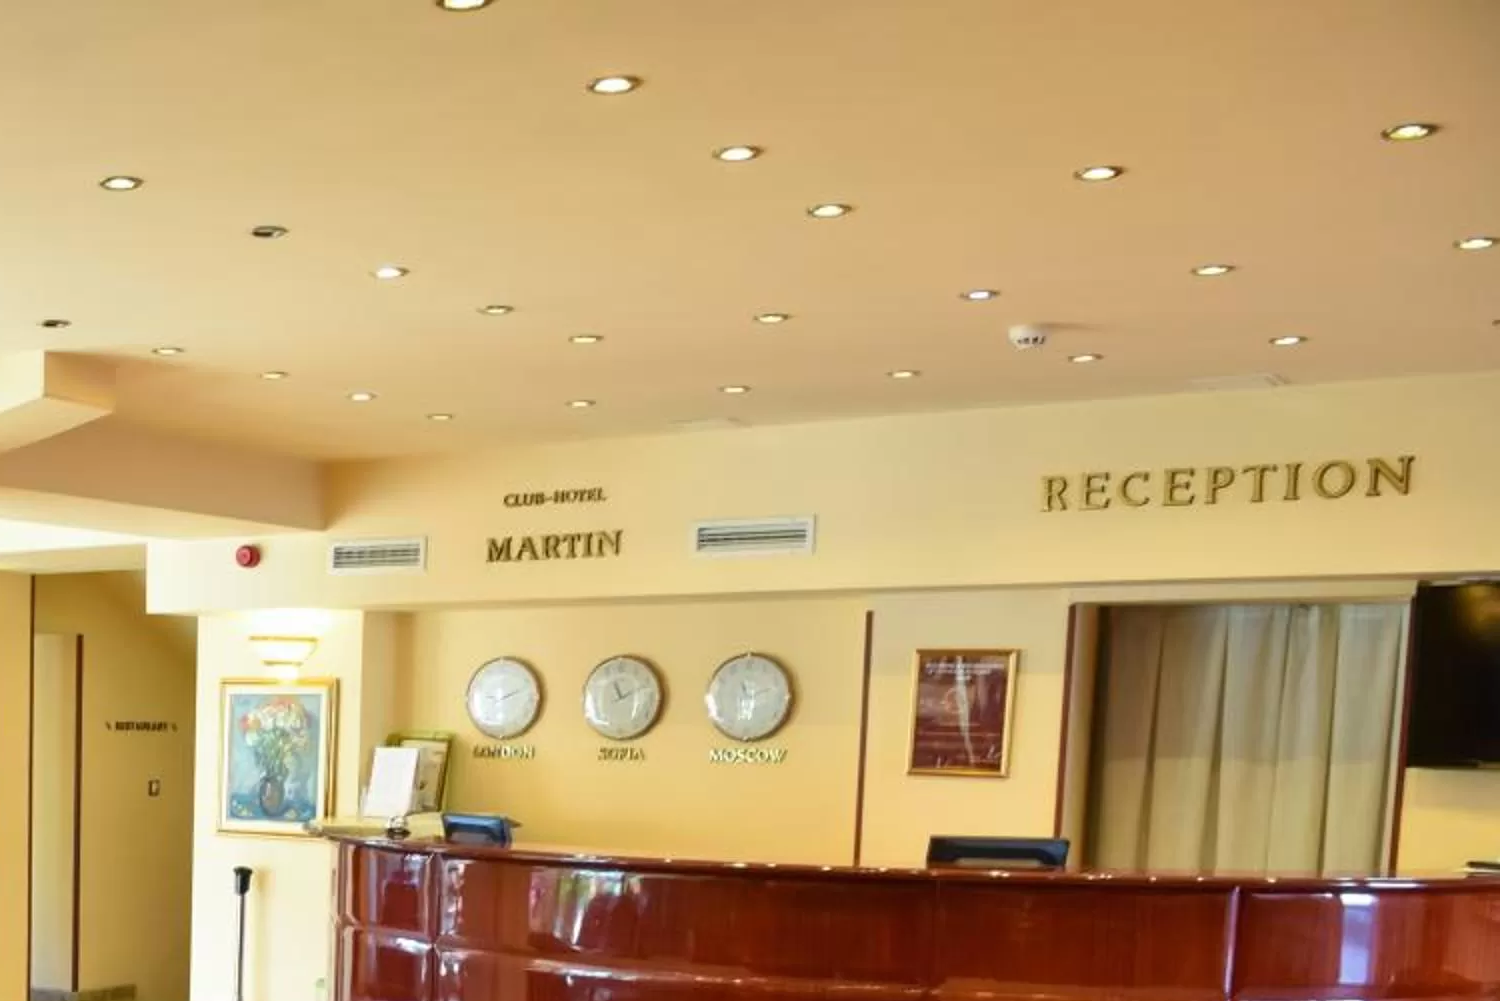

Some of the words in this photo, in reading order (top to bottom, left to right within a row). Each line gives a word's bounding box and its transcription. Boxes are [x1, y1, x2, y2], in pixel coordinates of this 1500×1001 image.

[1040, 456, 1415, 512] RECEPTION
[503, 488, 606, 507] CLUB-HOTEL
[486, 530, 623, 562] MARTIN
[473, 745, 536, 760] LONDON
[597, 746, 645, 761] SOFIA
[708, 747, 788, 765] MOSCOW
